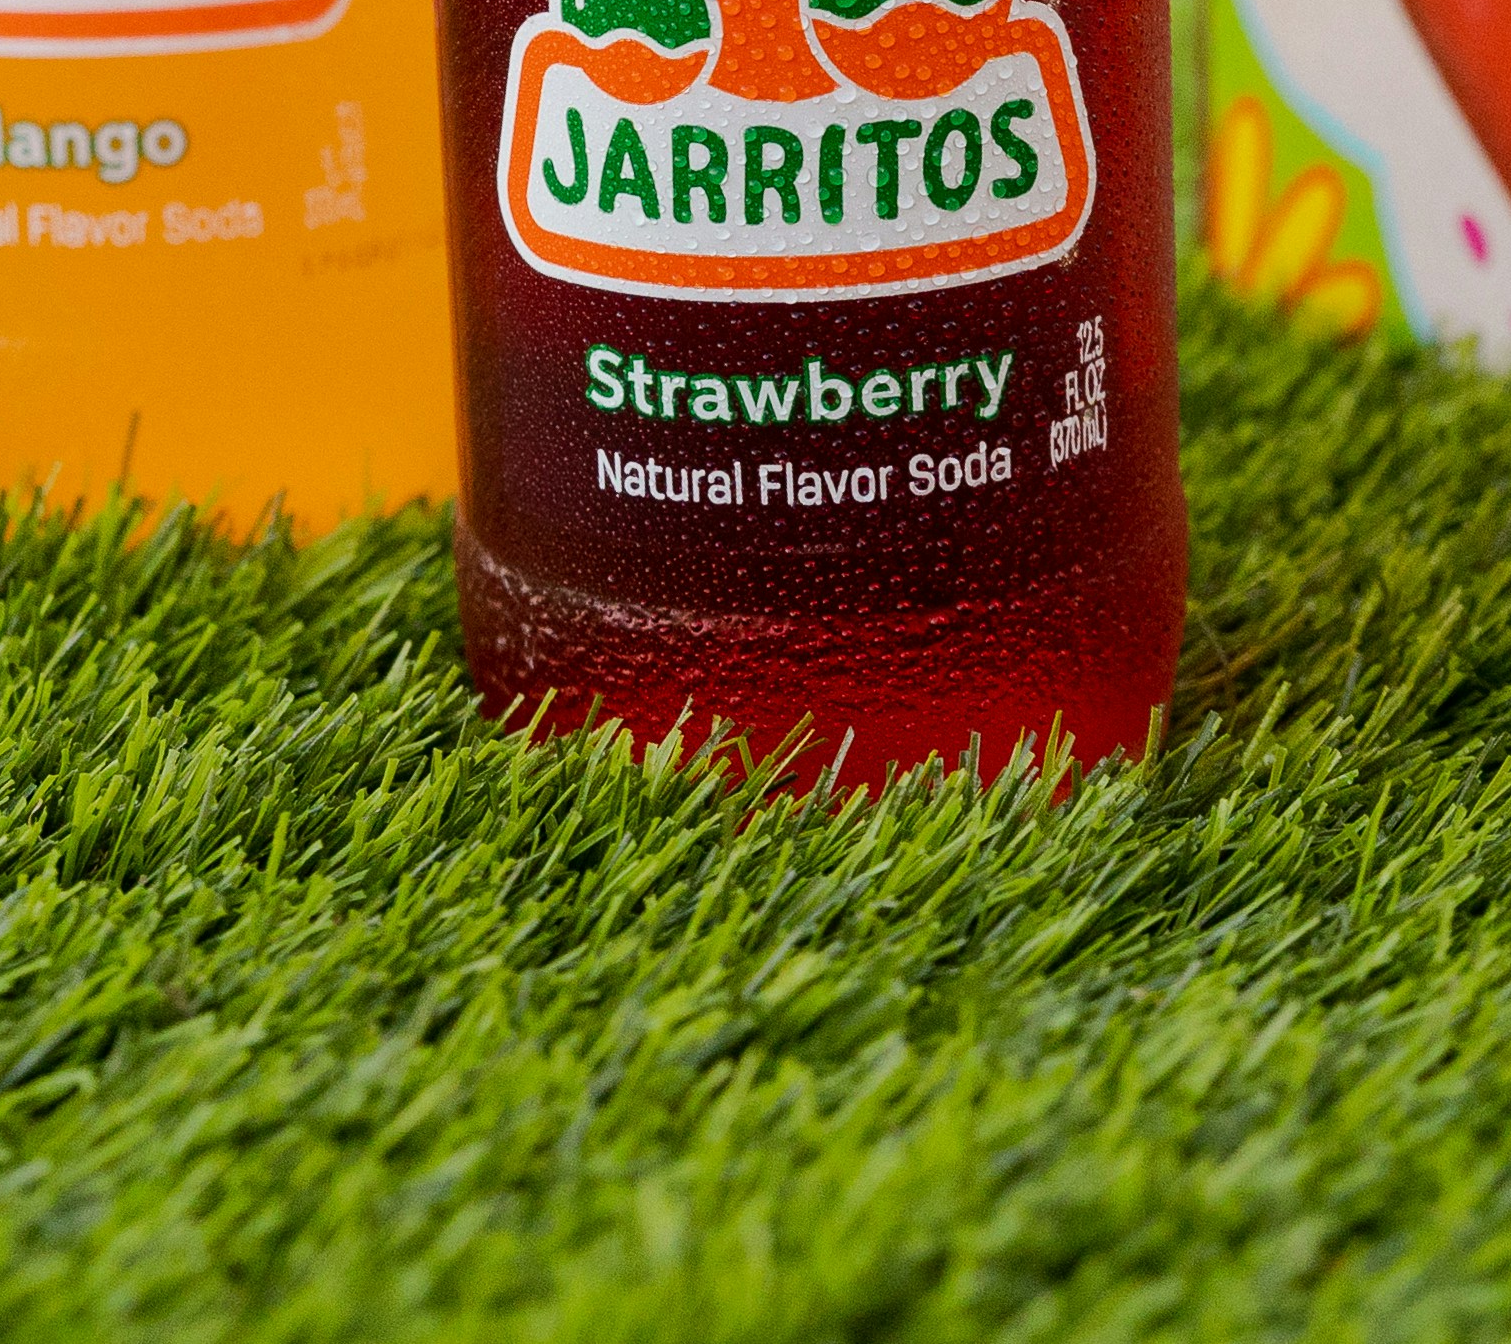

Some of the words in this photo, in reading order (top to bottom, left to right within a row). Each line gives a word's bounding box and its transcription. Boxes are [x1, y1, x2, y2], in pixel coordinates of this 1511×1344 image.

[541, 97, 1038, 227] JARRITOS
[1076, 315, 1104, 364] 12.5
[586, 343, 1015, 425] Strawberry
[1065, 370, 1084, 414] FL
[1085, 358, 1106, 405] OZ
[597, 448, 744, 506] Natural
[759, 462, 892, 507] Flavor
[908, 441, 1011, 496] Soda
